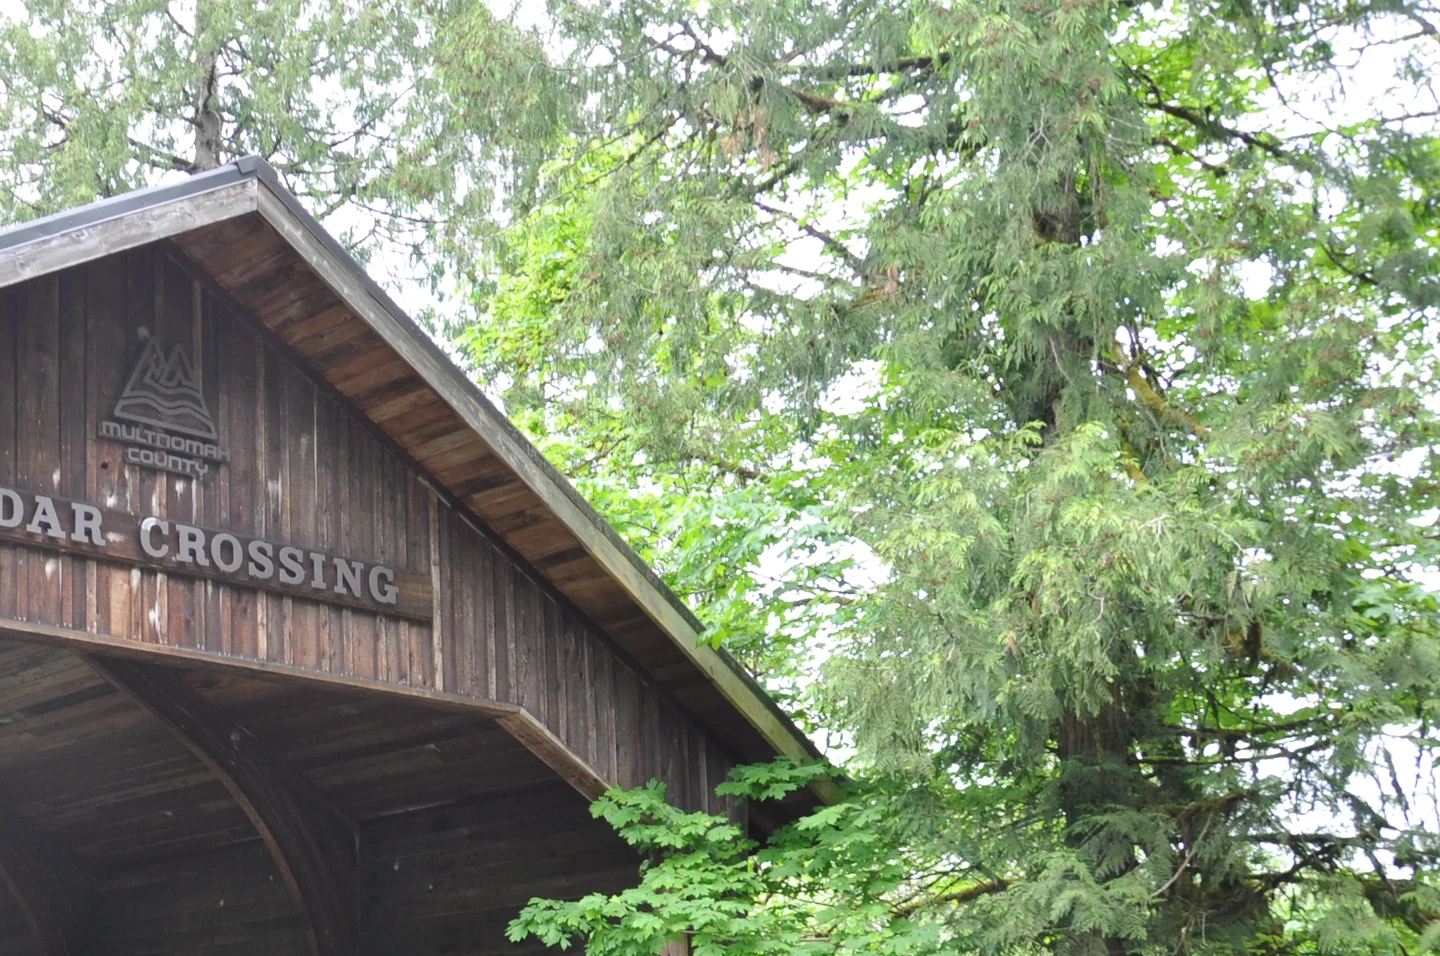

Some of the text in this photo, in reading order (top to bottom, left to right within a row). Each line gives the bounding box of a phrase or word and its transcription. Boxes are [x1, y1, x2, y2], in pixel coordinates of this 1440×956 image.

[101, 420, 231, 462] MULTNOMAH
[127, 447, 209, 481] COUNTY
[139, 516, 400, 605] CROSSING
